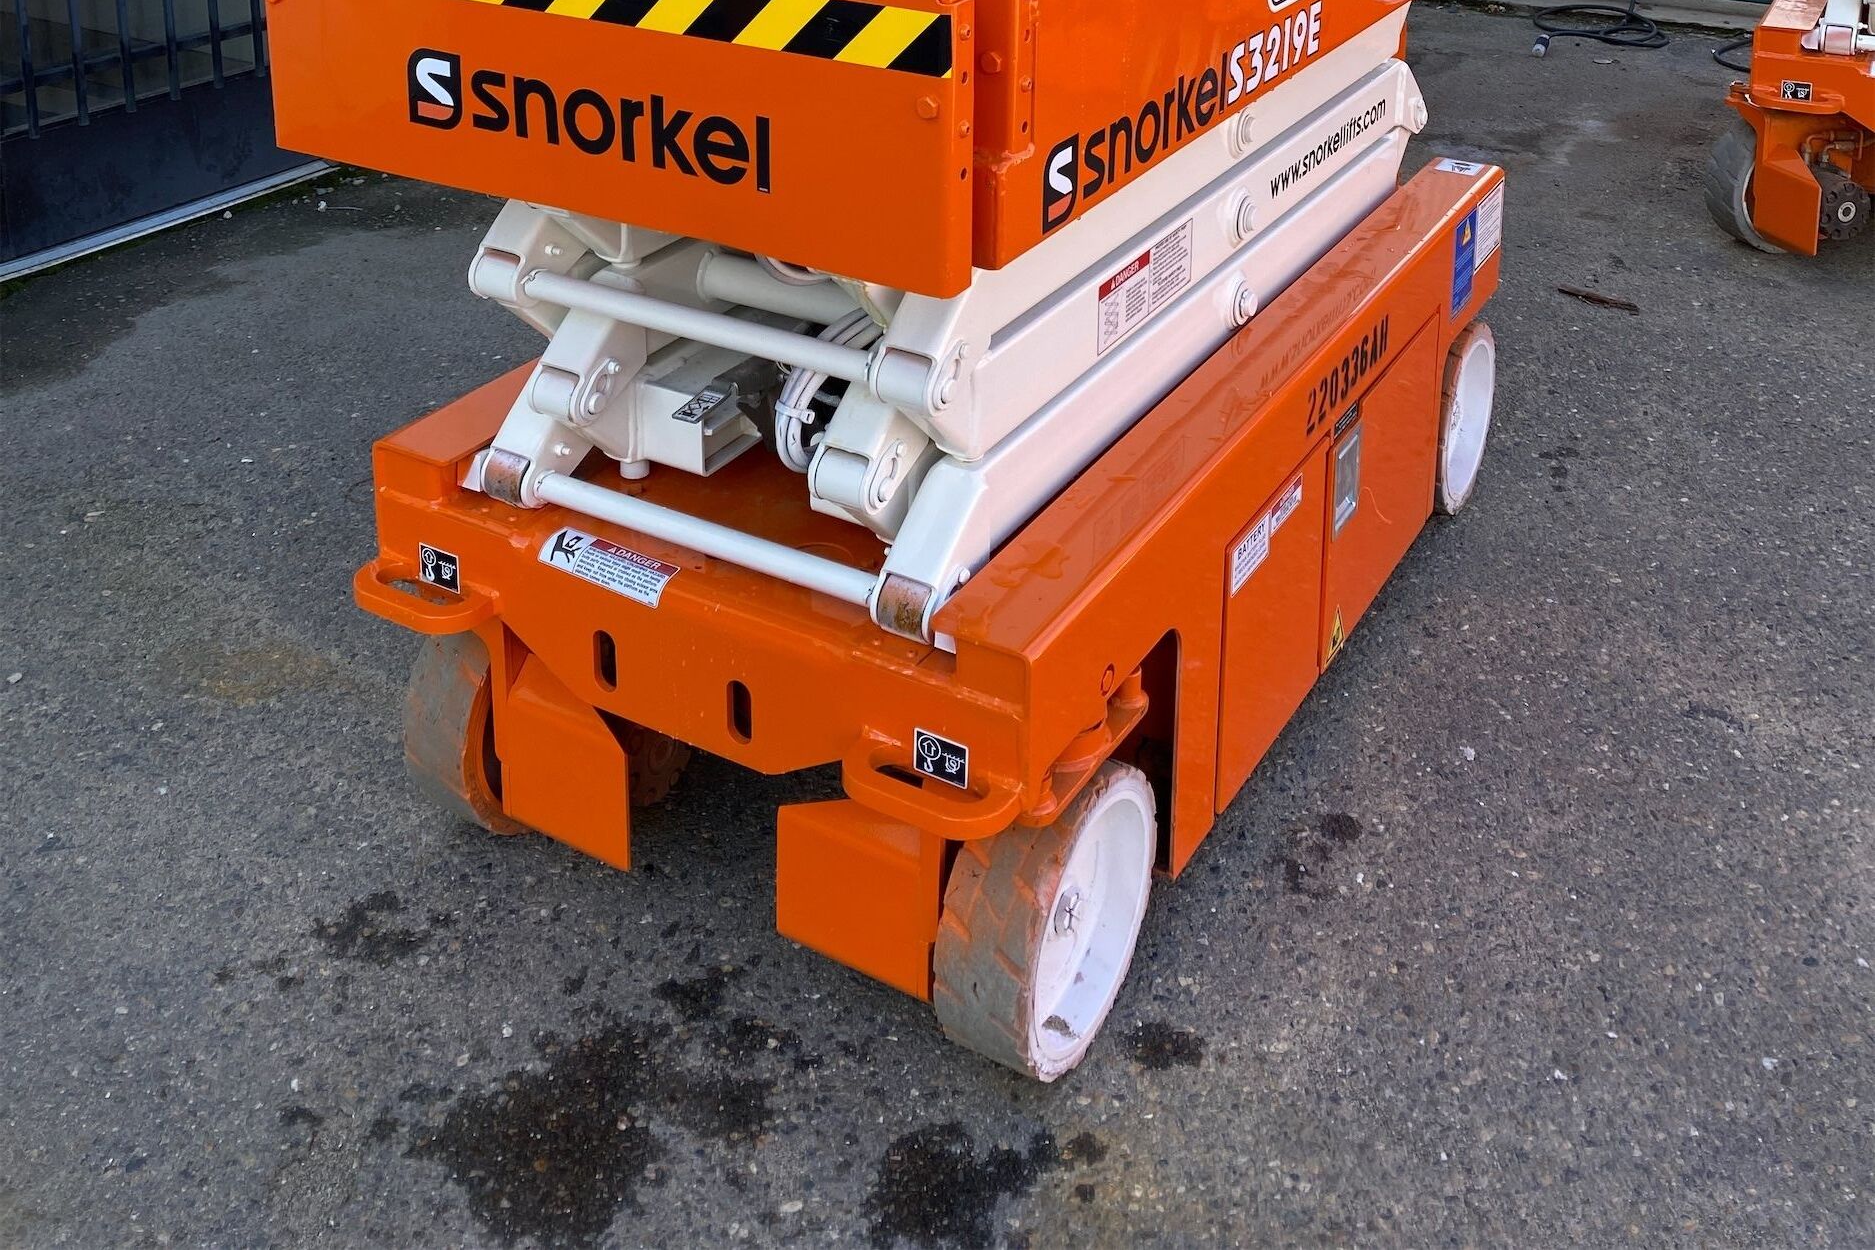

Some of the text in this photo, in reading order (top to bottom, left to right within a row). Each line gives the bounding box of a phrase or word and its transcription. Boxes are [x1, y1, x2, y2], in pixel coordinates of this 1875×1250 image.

[470, 68, 771, 194] snorkel
[1082, 51, 1228, 200] snorkel
[1270, 98, 1386, 200] www.snorkellifts.com
[1114, 260, 1140, 285] DANGER
[615, 548, 662, 570] DANGER
[1237, 520, 1266, 561] BATTERY
